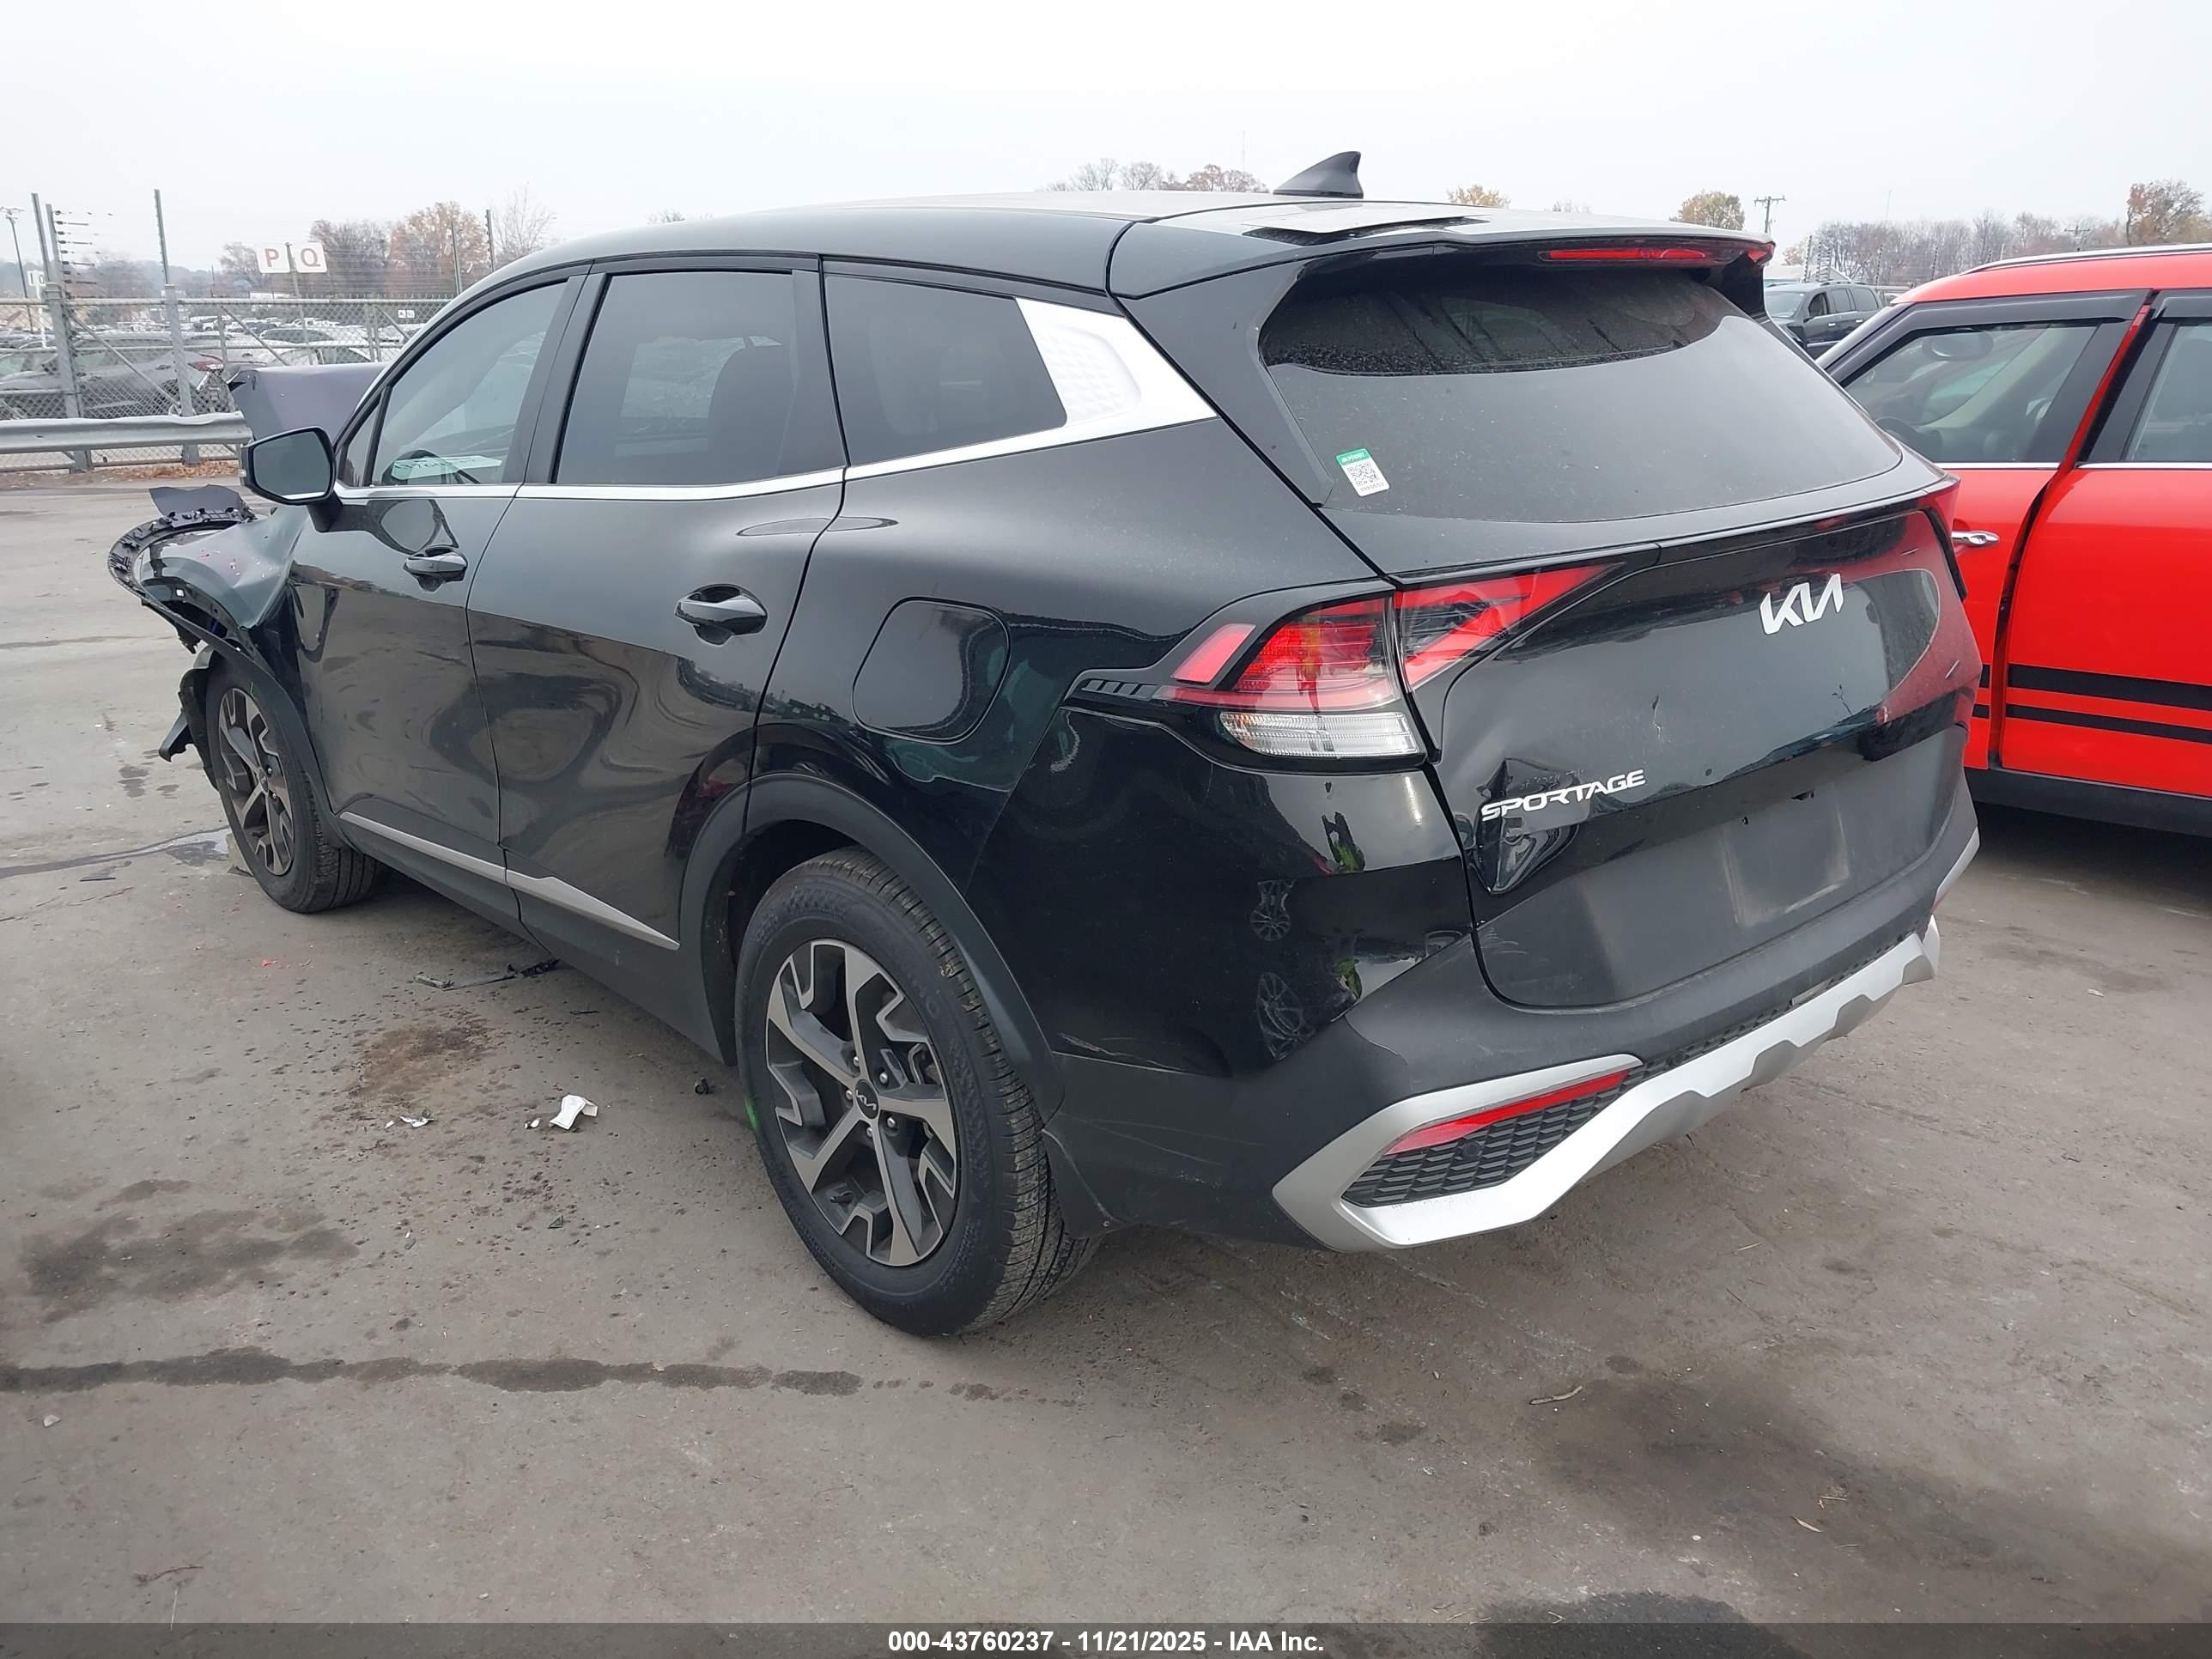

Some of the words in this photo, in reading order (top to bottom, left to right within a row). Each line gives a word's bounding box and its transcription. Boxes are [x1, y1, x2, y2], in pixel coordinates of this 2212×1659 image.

[264, 247, 280, 268] P
[300, 247, 321, 268] Q
[1759, 573, 1844, 635] KIA
[1480, 769, 1646, 823] SPORTAGE
